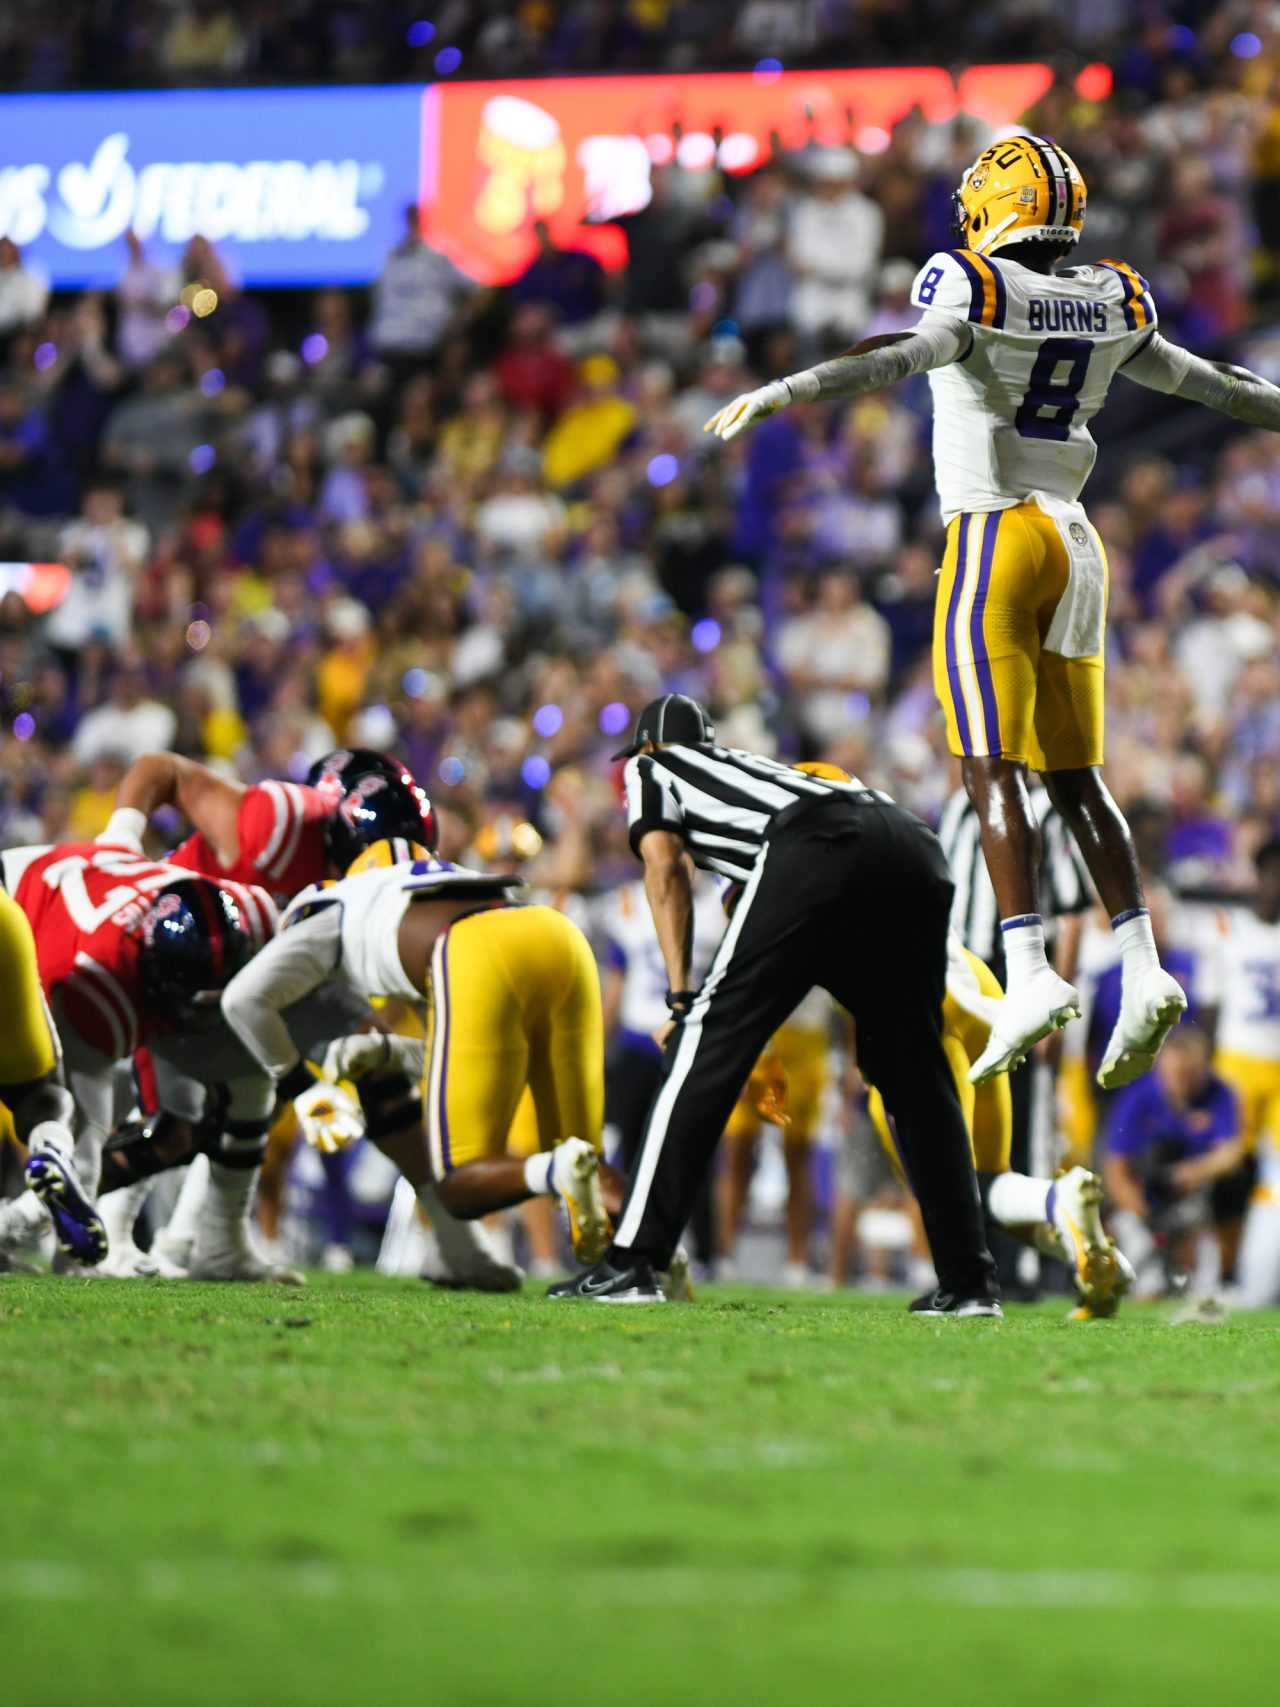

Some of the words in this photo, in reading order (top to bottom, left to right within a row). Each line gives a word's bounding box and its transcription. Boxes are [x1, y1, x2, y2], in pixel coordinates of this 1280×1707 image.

[1040, 227, 1075, 237] TIGERS
[918, 267, 945, 305] 8
[1029, 299, 1107, 333] BURNS
[1015, 338, 1095, 441] 8
